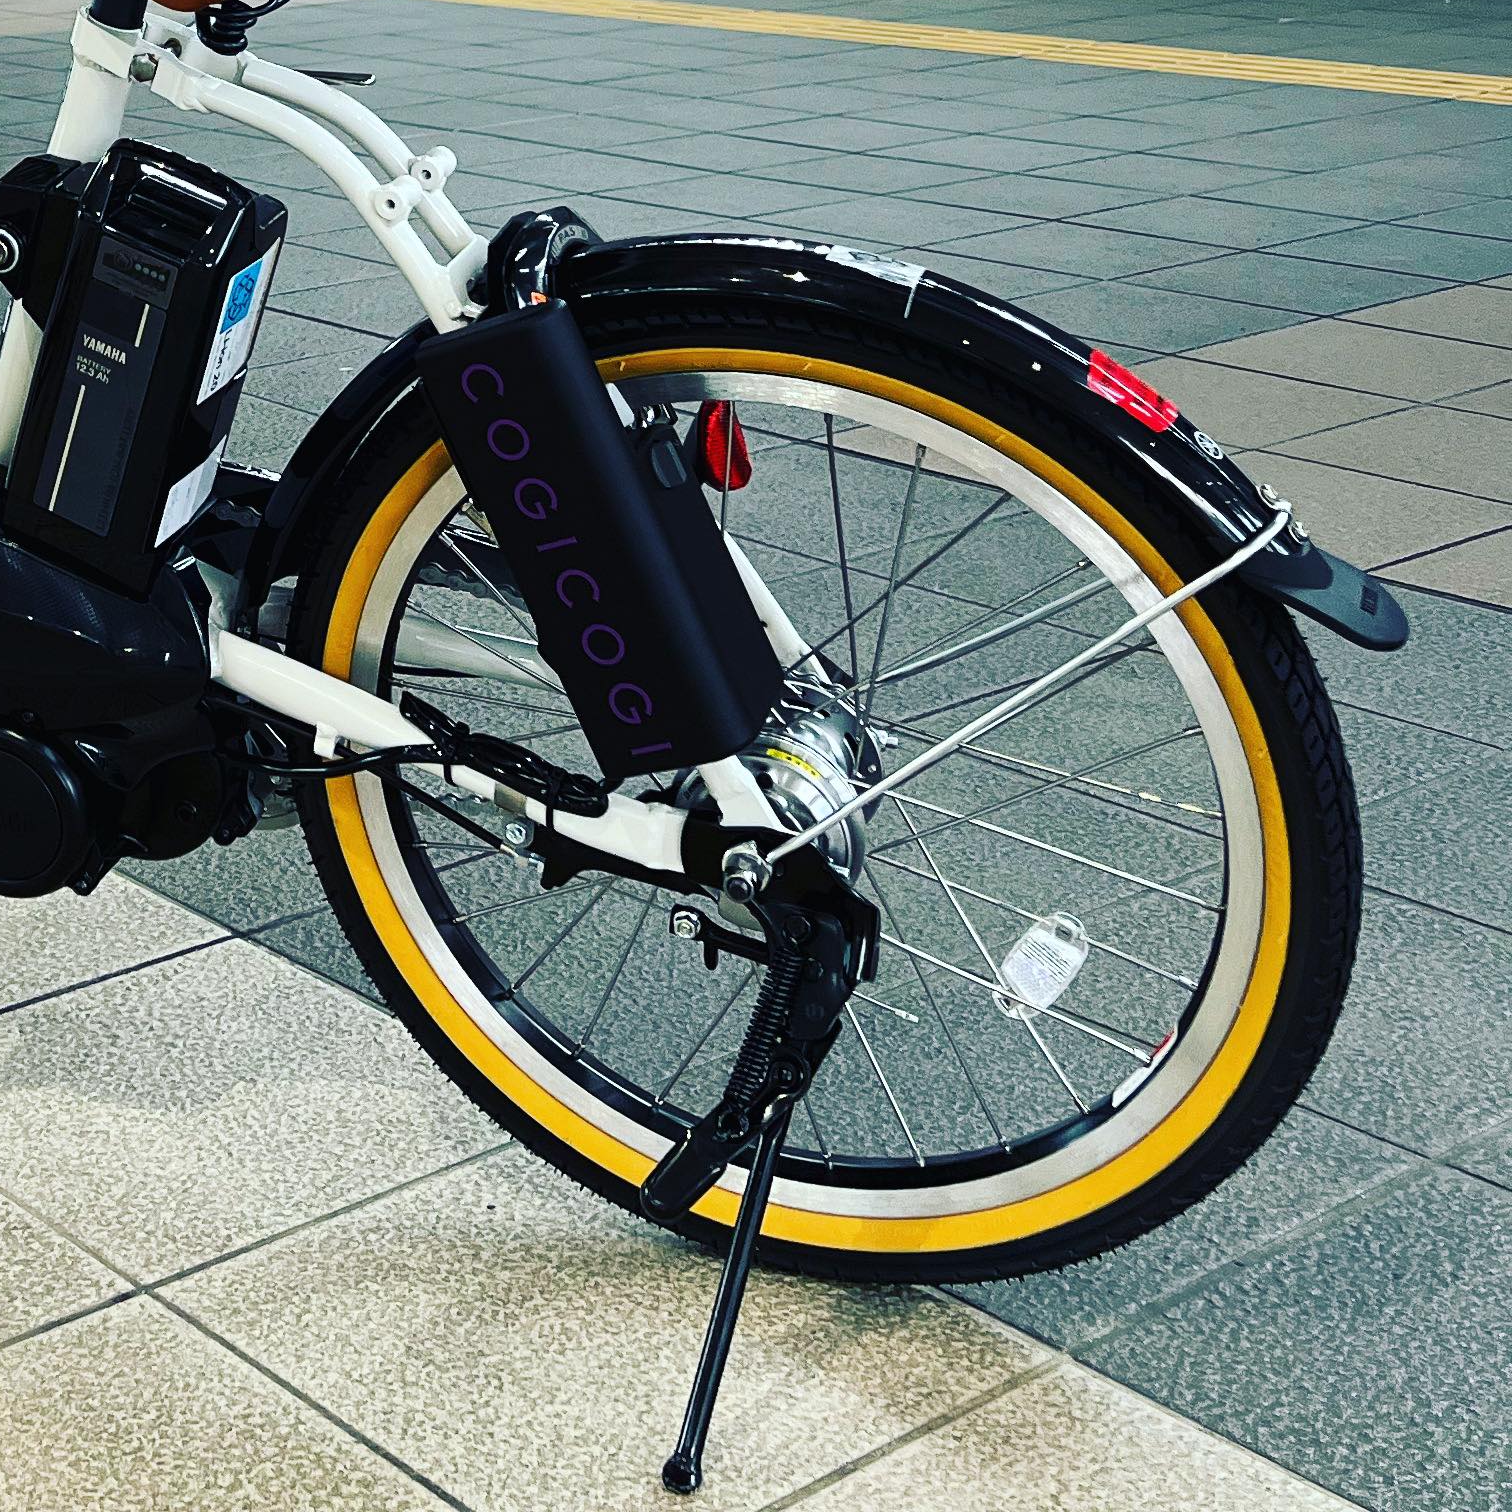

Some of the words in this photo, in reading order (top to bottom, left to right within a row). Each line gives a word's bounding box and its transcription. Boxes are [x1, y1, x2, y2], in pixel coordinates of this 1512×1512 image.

[83, 333, 126, 365] YAMAHA
[76, 354, 112, 375] BATTERY
[95, 371, 109, 385] Ah
[460, 363, 673, 755] COGICOGI
